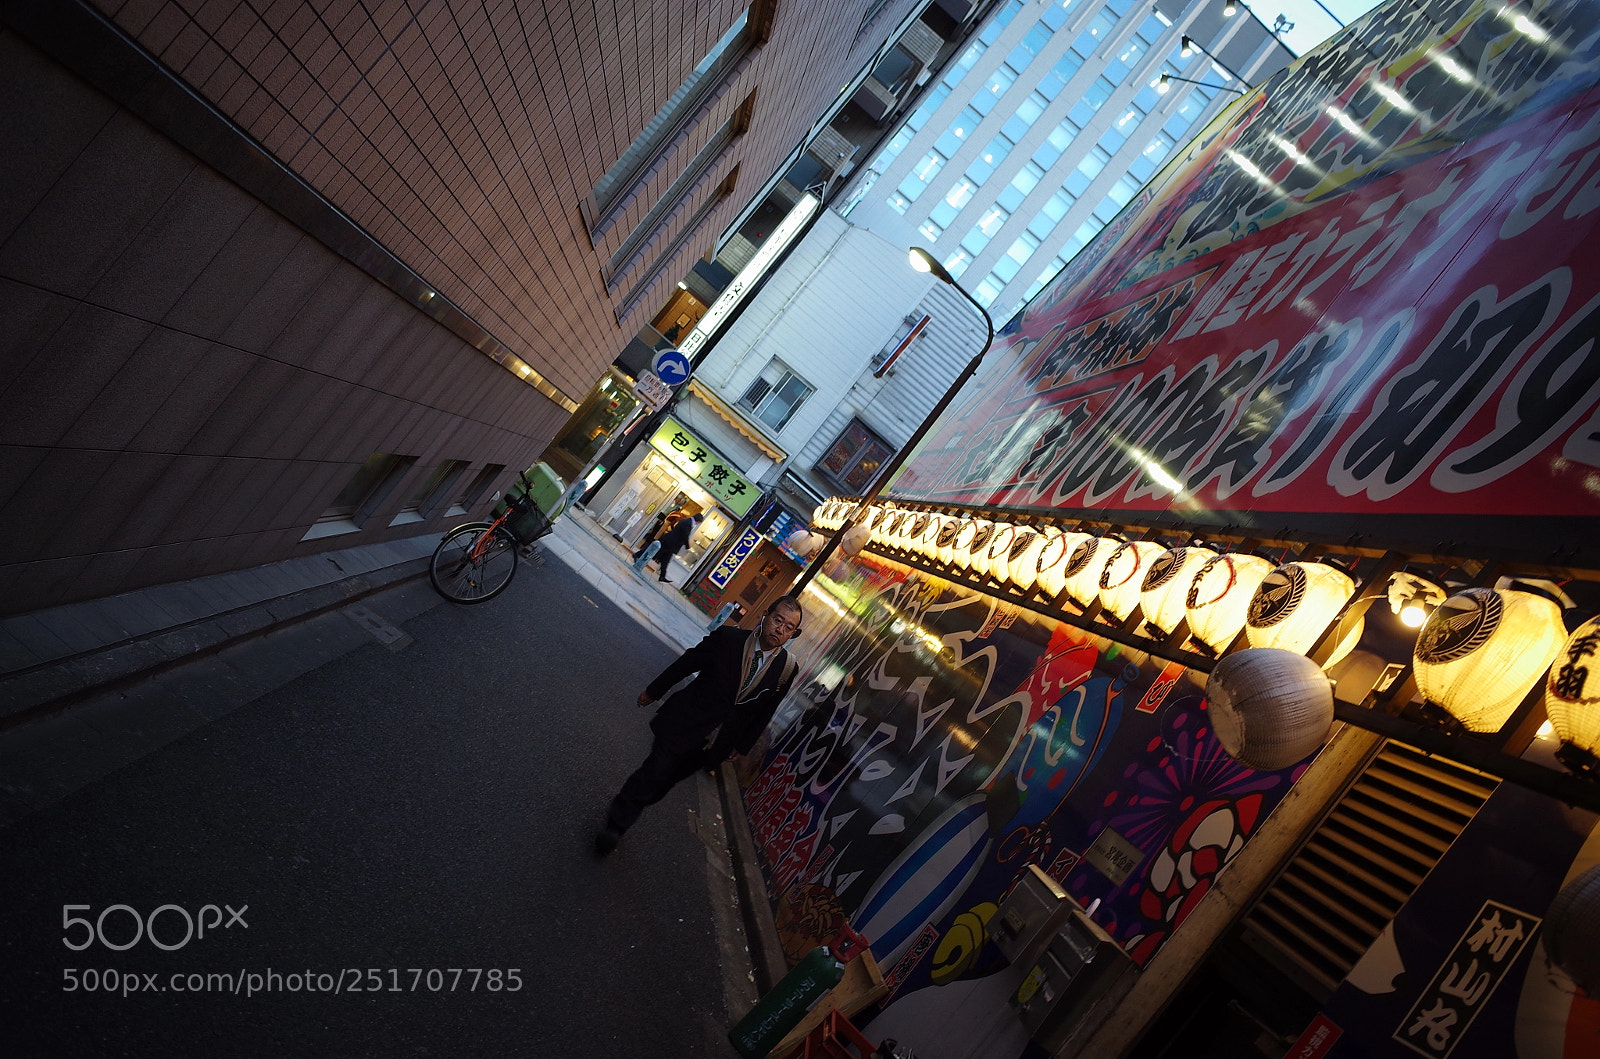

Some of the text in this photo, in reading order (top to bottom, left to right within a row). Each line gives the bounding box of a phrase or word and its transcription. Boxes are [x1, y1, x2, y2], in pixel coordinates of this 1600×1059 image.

[1025, 281, 1189, 394] 年中無休
[671, 432, 746, 494] 包子餃子
[941, 401, 1086, 485] 大型会
[717, 533, 755, 579] ろしあ亭
[1407, 910, 1525, 1051] 村山丸
